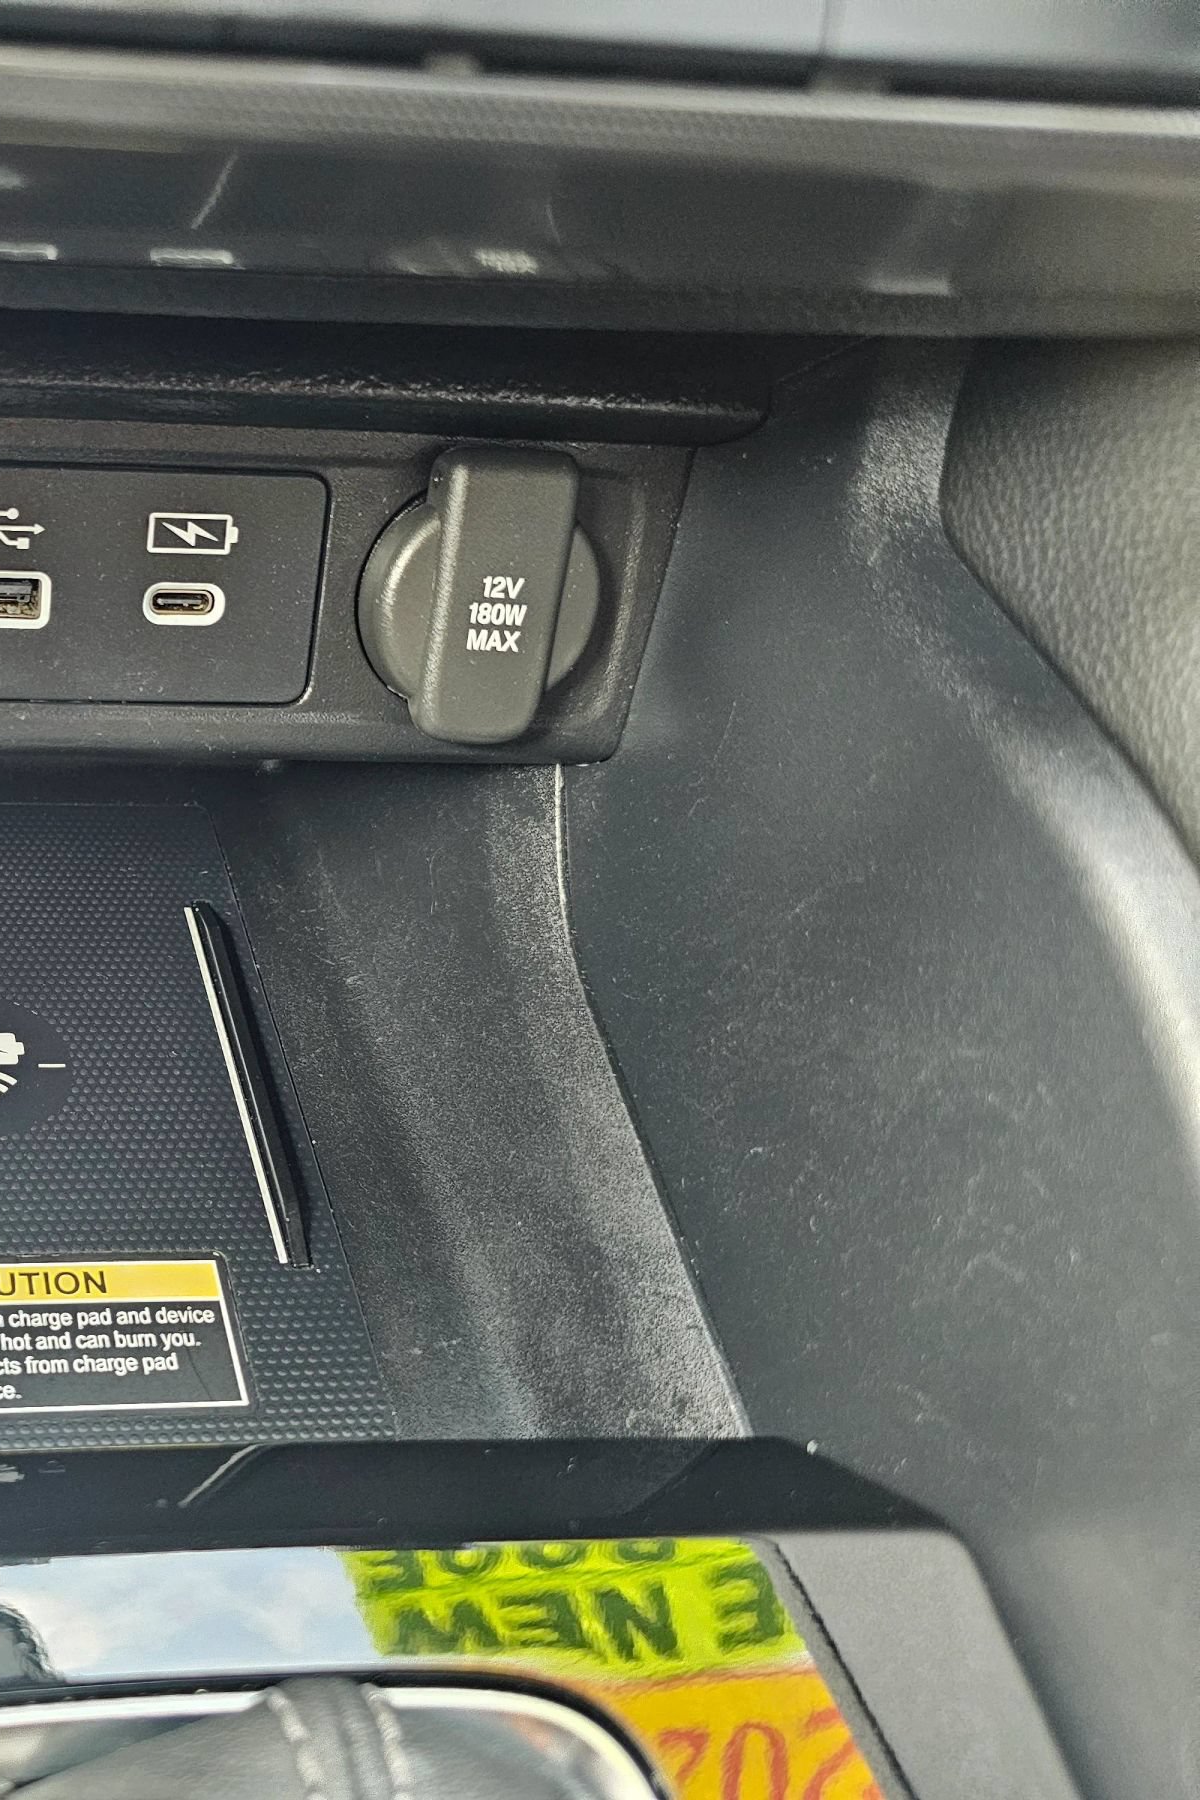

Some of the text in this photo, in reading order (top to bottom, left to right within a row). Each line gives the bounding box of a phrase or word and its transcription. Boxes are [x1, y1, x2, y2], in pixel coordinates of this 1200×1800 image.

[482, 575, 526, 600] 12V
[468, 601, 528, 627] 180W
[465, 628, 522, 653] MAX
[8, 1309, 73, 1331] charge
[77, 1307, 113, 1329] pad
[116, 1306, 152, 1325] and
[155, 1305, 216, 1324] device
[0, 1333, 32, 1351] hot
[35, 1332, 72, 1350] and
[75, 1333, 110, 1349] can
[113, 1329, 157, 1348] burn
[160, 1331, 202, 1352] you.
[25, 1355, 70, 1374] from
[73, 1354, 139, 1376] charge
[142, 1352, 179, 1375] pad
